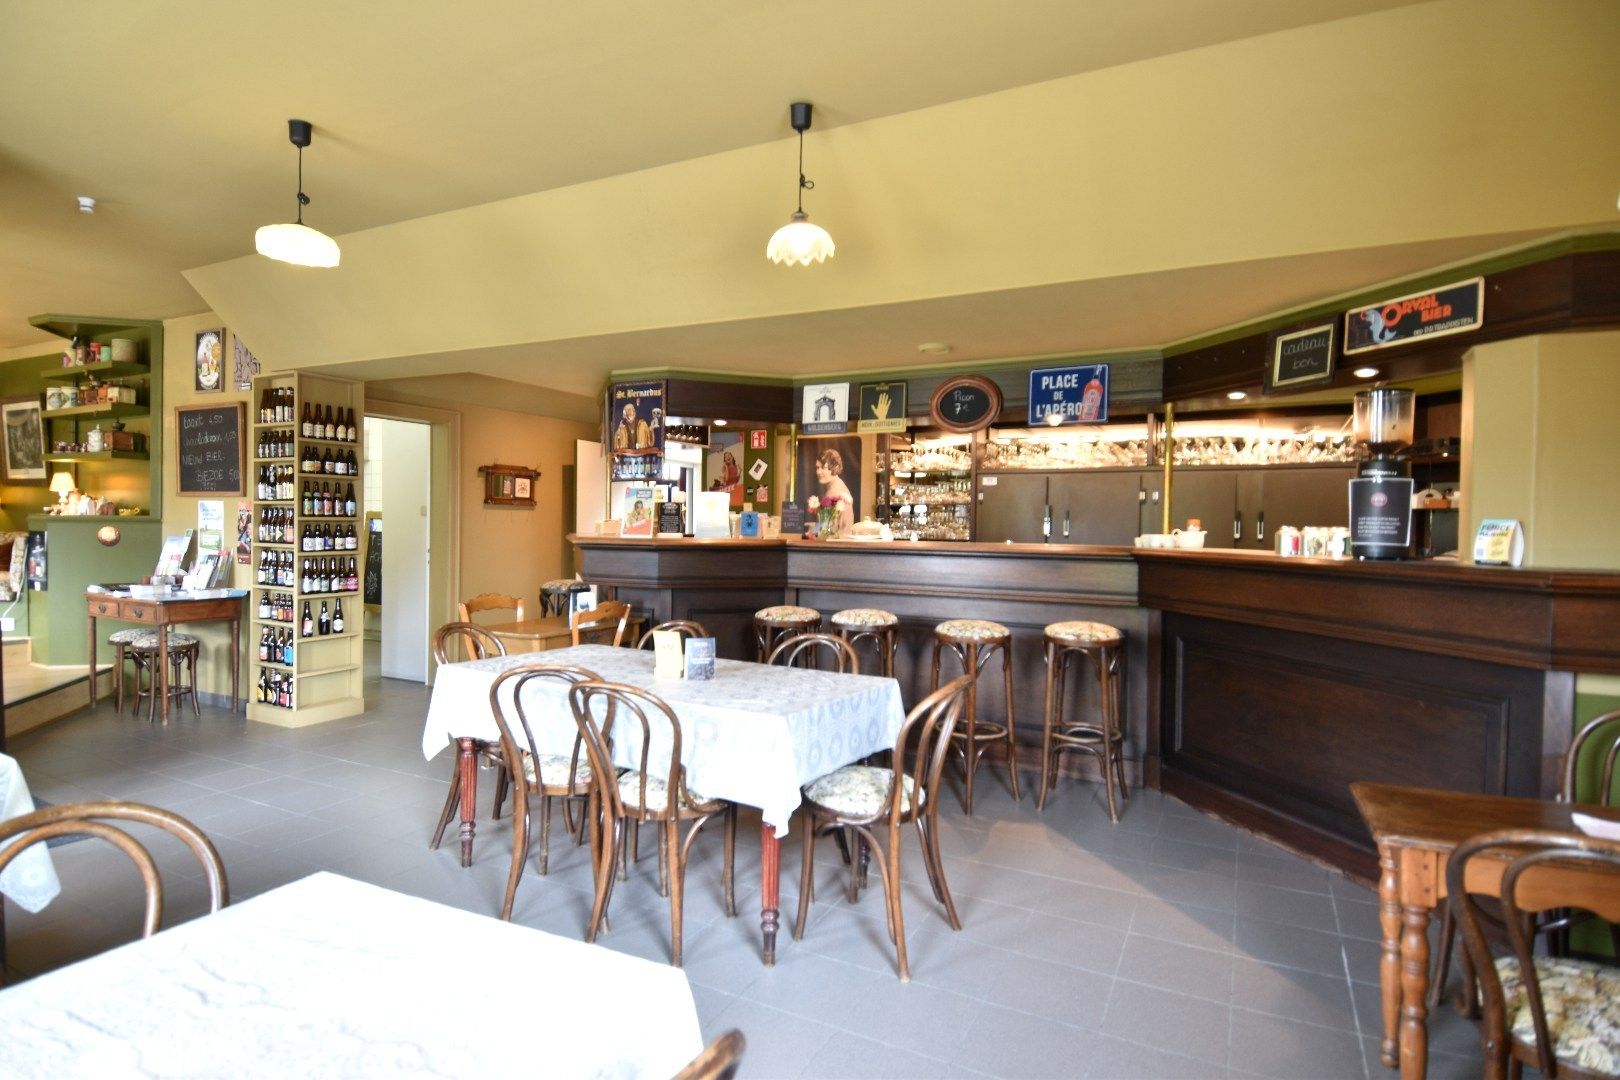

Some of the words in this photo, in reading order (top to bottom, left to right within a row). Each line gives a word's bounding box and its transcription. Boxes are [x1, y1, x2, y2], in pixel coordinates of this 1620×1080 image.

[1421, 304, 1453, 322] BIER
[1283, 336, 1327, 355] cadeau
[1041, 373, 1079, 390] PLACE
[627, 388, 662, 398] Bernardus
[1053, 390, 1064, 400] DE
[1035, 400, 1083, 419] L'APÉRO
